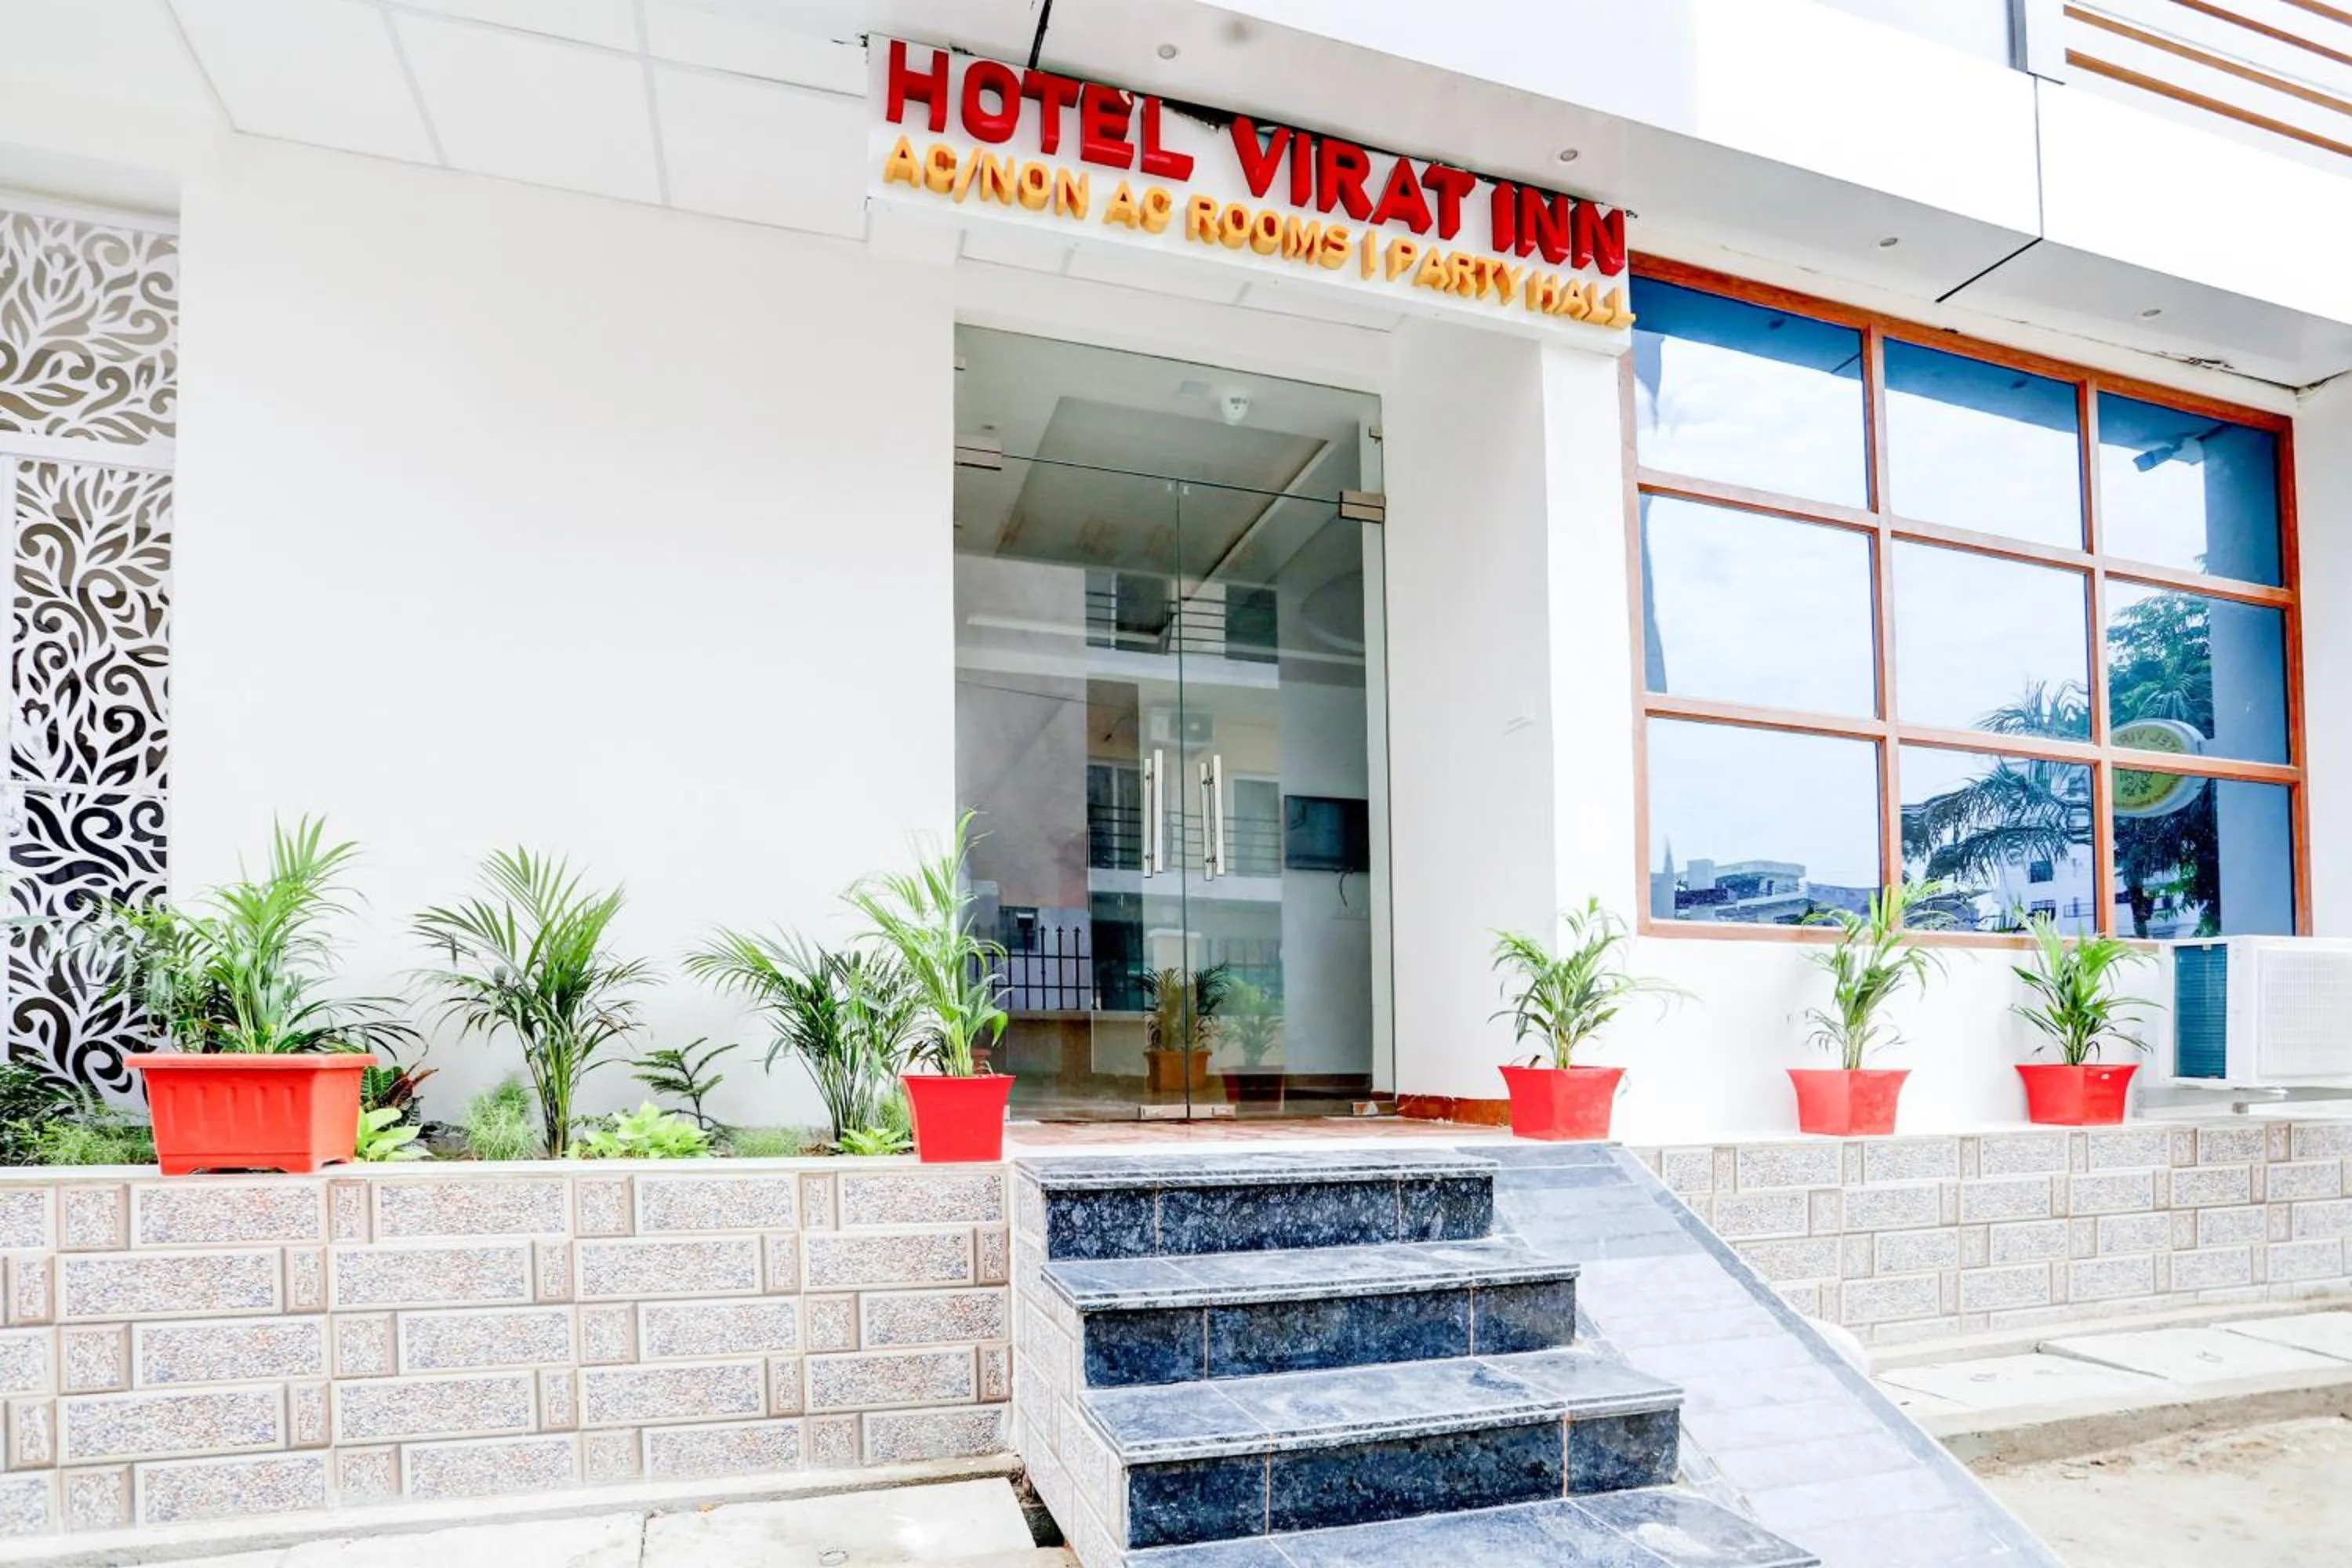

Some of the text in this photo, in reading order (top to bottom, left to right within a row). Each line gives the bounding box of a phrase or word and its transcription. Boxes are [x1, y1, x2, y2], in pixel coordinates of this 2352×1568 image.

[884, 135, 1090, 220] AC/NON
[1102, 180, 1173, 234] AC
[1185, 194, 1355, 270] ROOMS
[1385, 238, 1523, 307] PARTY
[1525, 270, 1636, 330] HALL
[886, 38, 1627, 278] HOTEL VIRAT INN
